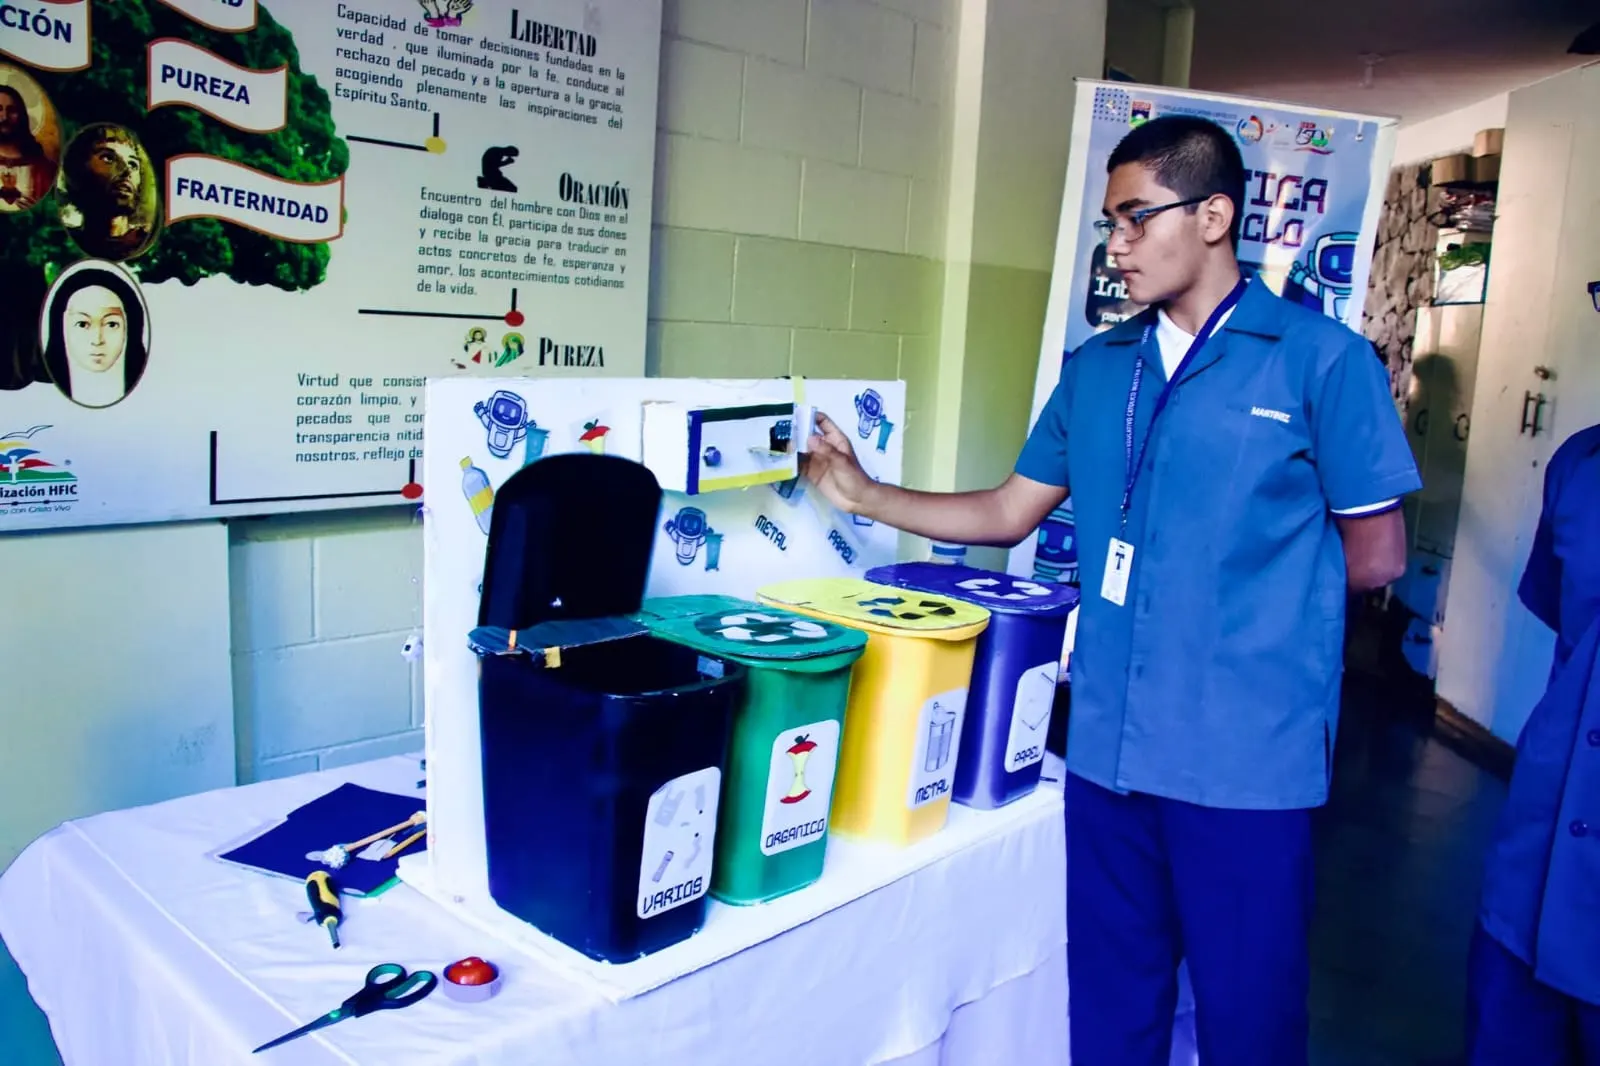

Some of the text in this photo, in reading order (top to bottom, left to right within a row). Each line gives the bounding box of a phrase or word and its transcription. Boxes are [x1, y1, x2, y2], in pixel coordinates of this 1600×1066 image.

[337, 3, 625, 80] Capacidad de tomar decisiones fundadas en la
[510, 9, 596, 57] LIBERTAD
[336, 27, 384, 46] verdad
[405, 43, 429, 57] que
[437, 45, 494, 70] iluminada
[502, 61, 522, 76] por
[529, 65, 539, 78] la
[566, 76, 609, 94] conduce
[615, 85, 625, 97] al
[336, 47, 391, 67] rechazo
[396, 56, 416, 72] del
[422, 62, 466, 83] pecado
[471, 75, 479, 87] y
[483, 76, 490, 87] a
[496, 75, 506, 90] la
[510, 80, 560, 103] apertura
[564, 91, 571, 103] a
[575, 91, 585, 105] la
[161, 64, 250, 105] PUREZA
[334, 82, 431, 112] Espíritu Santo.
[335, 65, 624, 130] acogiendo plenamente las inspiraciones del
[176, 177, 329, 224] FRATERNIDAD
[420, 187, 628, 224] Encuentro del hombre con Dios en el
[559, 172, 630, 210] ORACIÓN
[420, 206, 463, 224] dialoga
[467, 215, 489, 225] con
[509, 218, 558, 234] participa
[561, 222, 574, 235] de
[577, 228, 595, 237] sus
[598, 227, 627, 240] dones
[1240, 212, 1304, 247] CLO
[419, 228, 626, 256] y recibe la gracia para traducir en
[418, 245, 452, 257] actos
[459, 248, 517, 263] concretos
[524, 252, 537, 264] de
[562, 258, 614, 273] esperanza
[620, 264, 626, 274] y
[417, 280, 431, 292] de
[435, 281, 446, 293] la
[458, 264, 476, 277] los
[480, 268, 570, 285] acontecimientos
[574, 274, 625, 288] cotidianos
[538, 337, 604, 367] PUREZA
[297, 373, 339, 387] Virtud
[349, 376, 373, 389] que
[296, 393, 352, 406] corazón
[410, 396, 417, 407] y
[296, 412, 352, 427] pecados
[367, 413, 391, 425] que
[296, 428, 424, 445] transparencia nitid
[363, 447, 405, 461] reflejo
[49, 484, 78, 496] HFIC
[755, 514, 787, 551] METAL
[828, 529, 855, 564] PAPEL
[1013, 745, 1040, 765] PAPEL
[913, 779, 949, 805] METAL
[765, 818, 825, 849] ORGANICO
[642, 876, 703, 915] VARIOS
